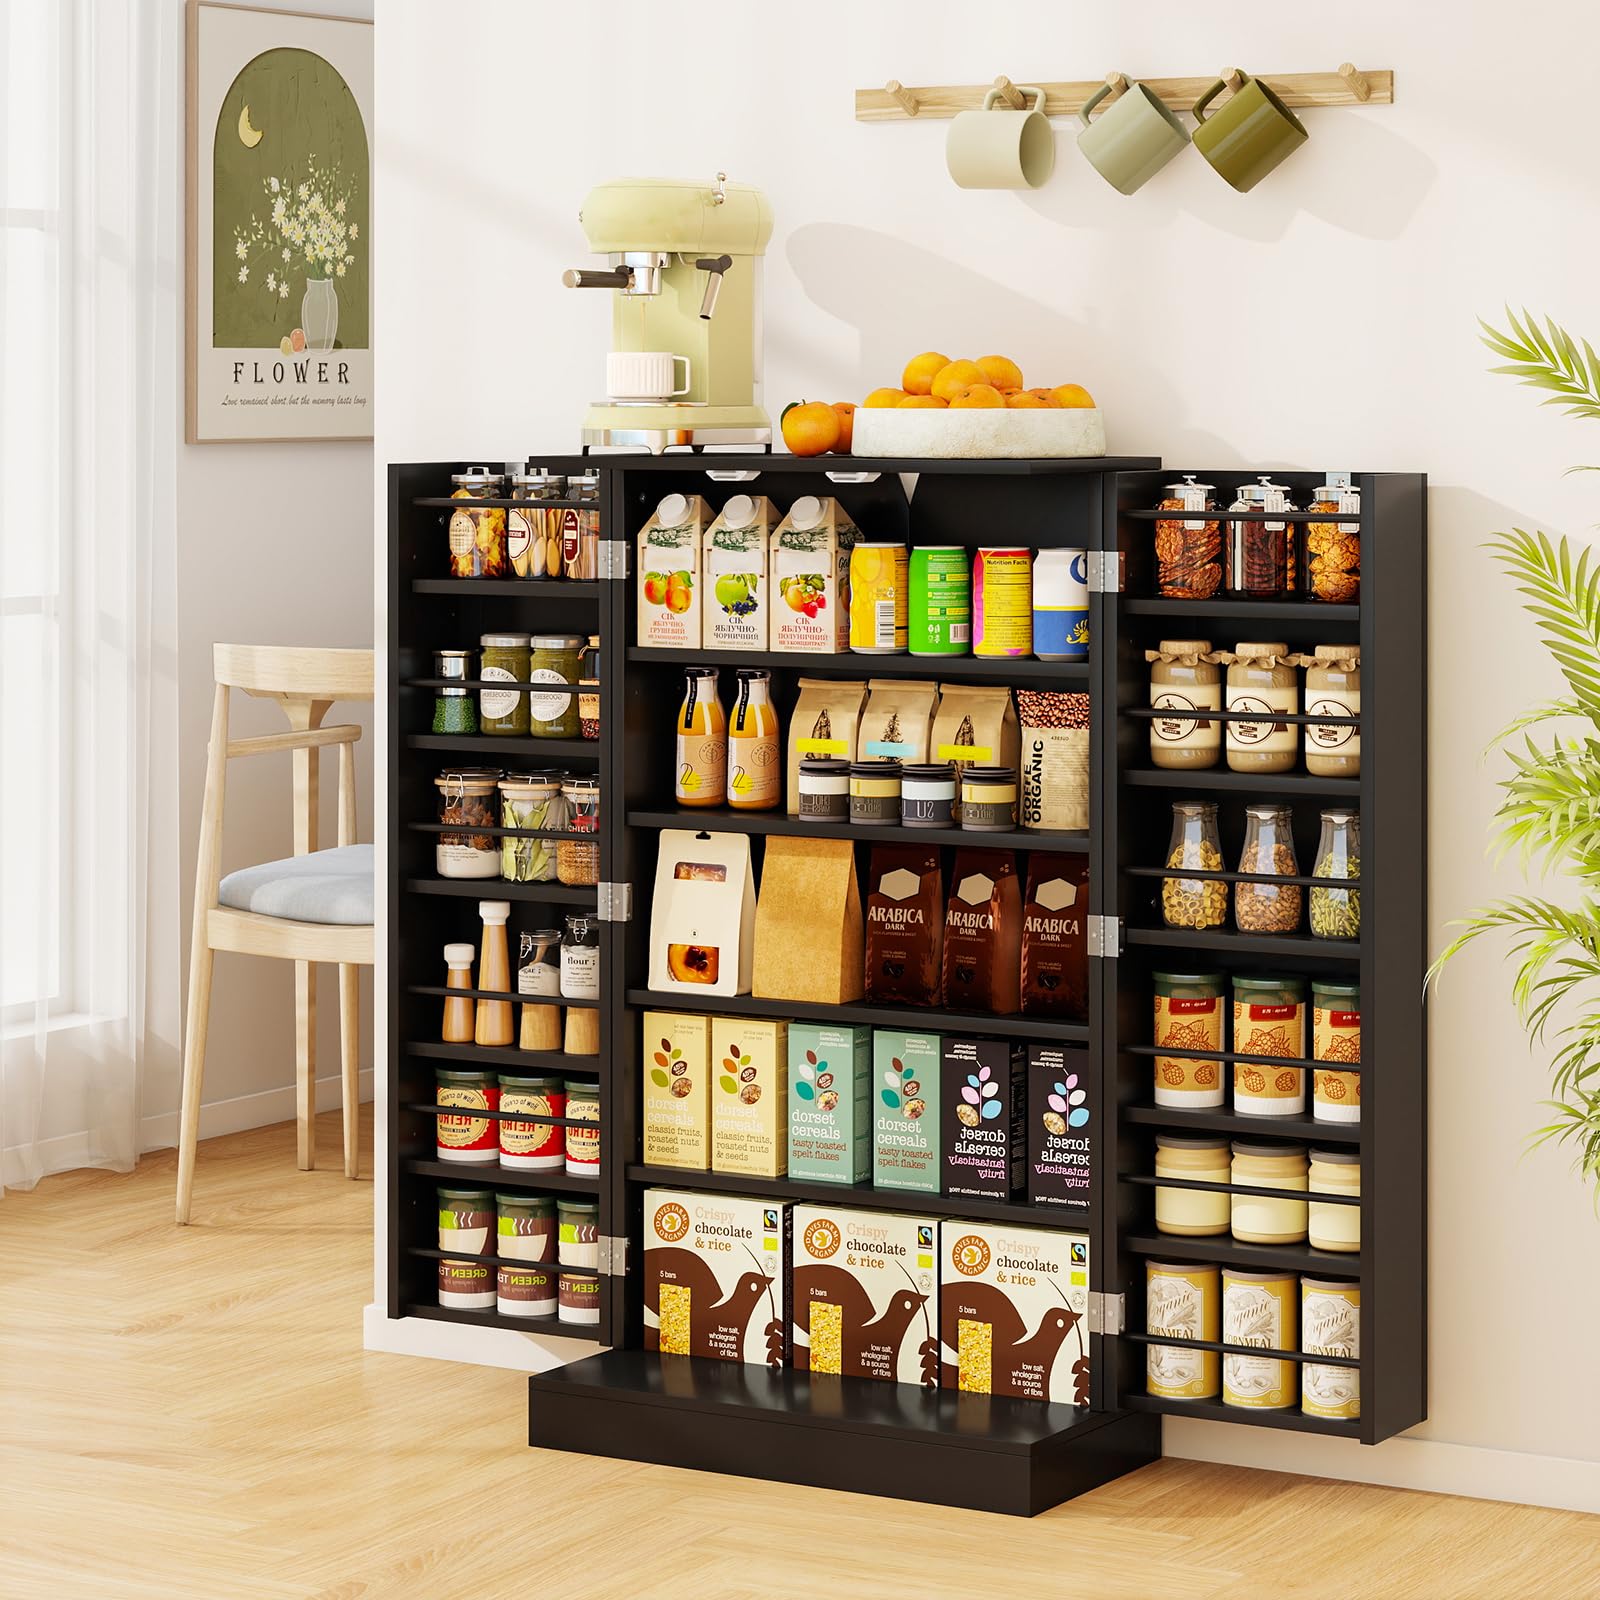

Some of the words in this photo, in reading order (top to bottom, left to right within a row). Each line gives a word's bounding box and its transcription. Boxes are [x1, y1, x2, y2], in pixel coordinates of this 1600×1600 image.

[233, 358, 350, 384] FLOWER
[221, 395, 236, 406] Love
[239, 396, 268, 406] remained
[288, 395, 299, 406] but
[300, 395, 310, 405] the
[312, 396, 334, 407] memory
[336, 395, 351, 405] lasts
[353, 395, 367, 407] long
[796, 617, 810, 625] СІК
[1032, 740, 1044, 823] ORGANIC
[868, 905, 924, 924] ARABICA
[946, 910, 993, 930] ARABICA
[885, 922, 905, 931] DARK
[959, 927, 977, 936] DARK
[1023, 915, 1079, 935] ARABICA
[1040, 933, 1060, 942] DARK
[568, 957, 589, 965] flour
[792, 1109, 836, 1125] dorset
[647, 1124, 676, 1135] classic
[877, 1117, 922, 1134] dorset
[716, 1131, 745, 1142] classic
[792, 1125, 841, 1140] cereals
[647, 1134, 679, 1145] roasted
[680, 1137, 700, 1147] nuts
[792, 1139, 814, 1150] tasty
[815, 1140, 847, 1152] toasted
[877, 1133, 928, 1148] cereals
[656, 1144, 680, 1154] seeds
[716, 1141, 748, 1152] roasted
[749, 1144, 770, 1154] nuts
[878, 1147, 900, 1158] tasty
[901, 1148, 934, 1160] toasted
[725, 1151, 749, 1161] seeds
[792, 1149, 814, 1160] spelt
[814, 1149, 840, 1161] flakes
[878, 1157, 900, 1168] spelt
[901, 1158, 926, 1170] flakes
[655, 1204, 671, 1227] DOVES
[671, 1204, 688, 1220] FARM
[695, 1206, 736, 1223] Crispy
[658, 1224, 688, 1241] ORGANIC
[695, 1222, 753, 1239] chocolate
[805, 1220, 821, 1243] DOVES
[822, 1220, 839, 1237] FARM
[846, 1222, 889, 1240] Crispy
[695, 1237, 705, 1249] &
[708, 1239, 732, 1252] rice
[808, 1240, 839, 1258] ORGANIC
[846, 1238, 907, 1256] chocolate
[953, 1236, 970, 1259] DOVES
[971, 1236, 989, 1254] FARM
[996, 1239, 1041, 1257] Crispy
[846, 1254, 857, 1266] &
[860, 1256, 885, 1269] rice
[957, 1257, 989, 1275] ORGANIC
[996, 1255, 1059, 1273] chocolate
[665, 1271, 677, 1279] bars
[996, 1271, 1007, 1283] &
[1010, 1273, 1036, 1286] rice
[809, 1287, 814, 1295] 5
[815, 1289, 827, 1297] bars
[958, 1305, 963, 1313] 5
[964, 1306, 977, 1315] bars
[718, 1325, 727, 1333] low
[708, 1332, 737, 1342] wholegrain
[719, 1342, 737, 1350] source
[870, 1343, 880, 1352] low
[726, 1349, 738, 1358] fibre
[860, 1351, 890, 1361] wholegrain
[872, 1368, 879, 1376] of
[879, 1369, 891, 1377] fibre
[1021, 1362, 1031, 1371] low
[1011, 1370, 1041, 1380] wholegrain
[1022, 1381, 1041, 1389] source
[1030, 1388, 1043, 1397] fibre
